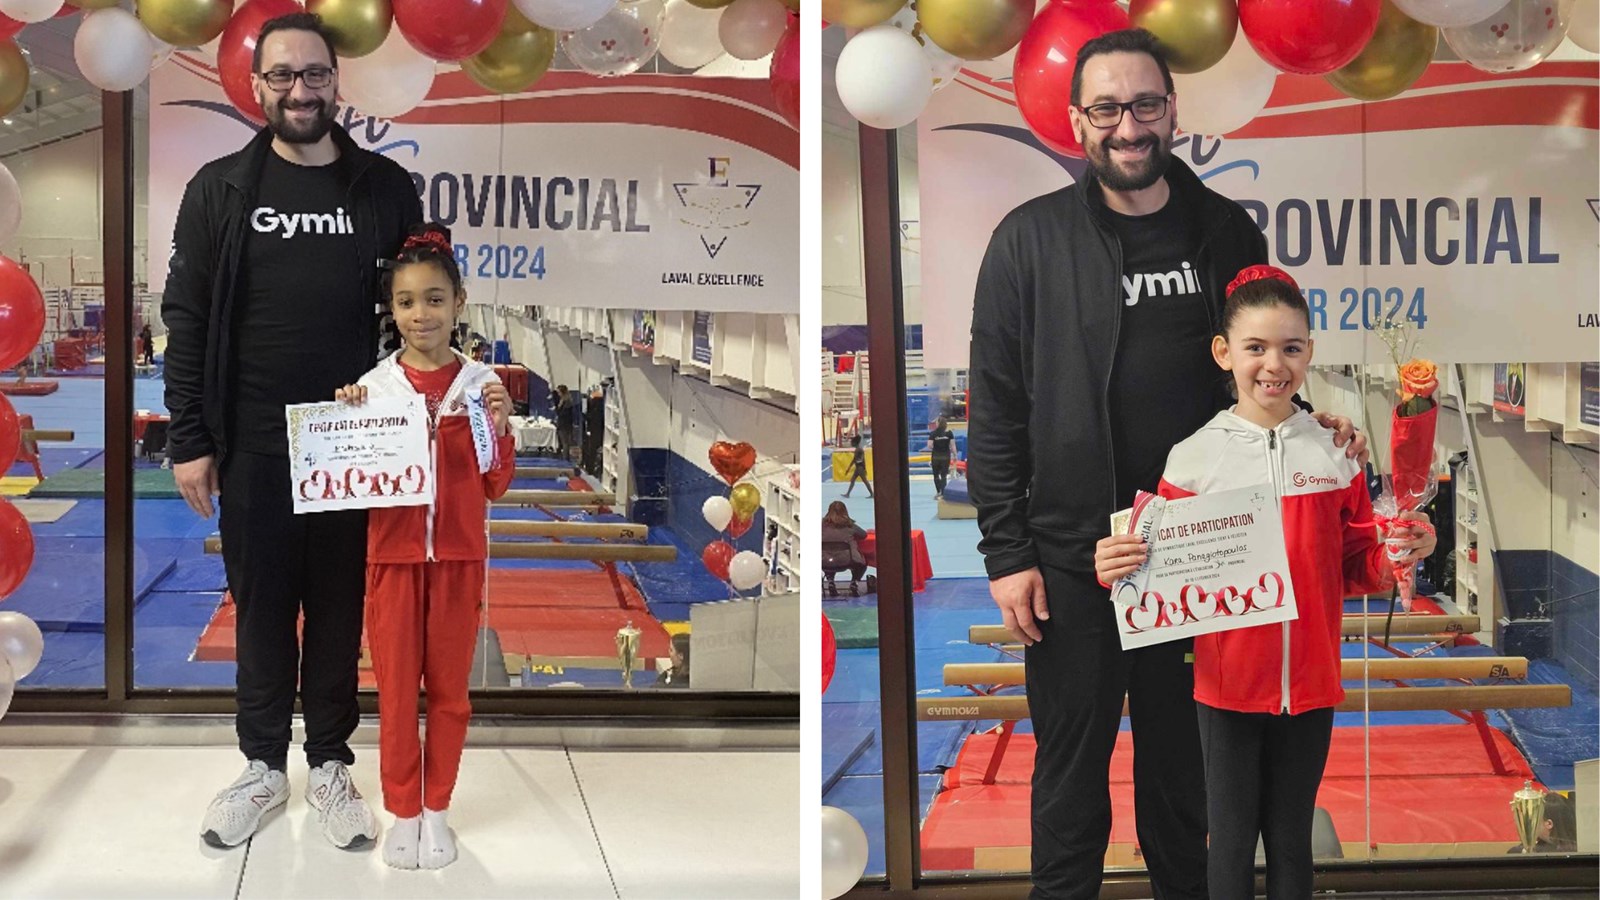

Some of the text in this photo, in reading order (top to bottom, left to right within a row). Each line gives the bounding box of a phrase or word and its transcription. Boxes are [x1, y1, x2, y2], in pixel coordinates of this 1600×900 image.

[477, 244, 546, 280] 2024
[661, 272, 764, 287] LAVAL EXCELLENCE
[1339, 287, 1428, 331] 2024
[1308, 475, 1338, 485] Gymini
[1177, 525, 1190, 537] DE
[1190, 512, 1255, 535] PARTICIPATION
[927, 706, 980, 715] GYMNOVA
